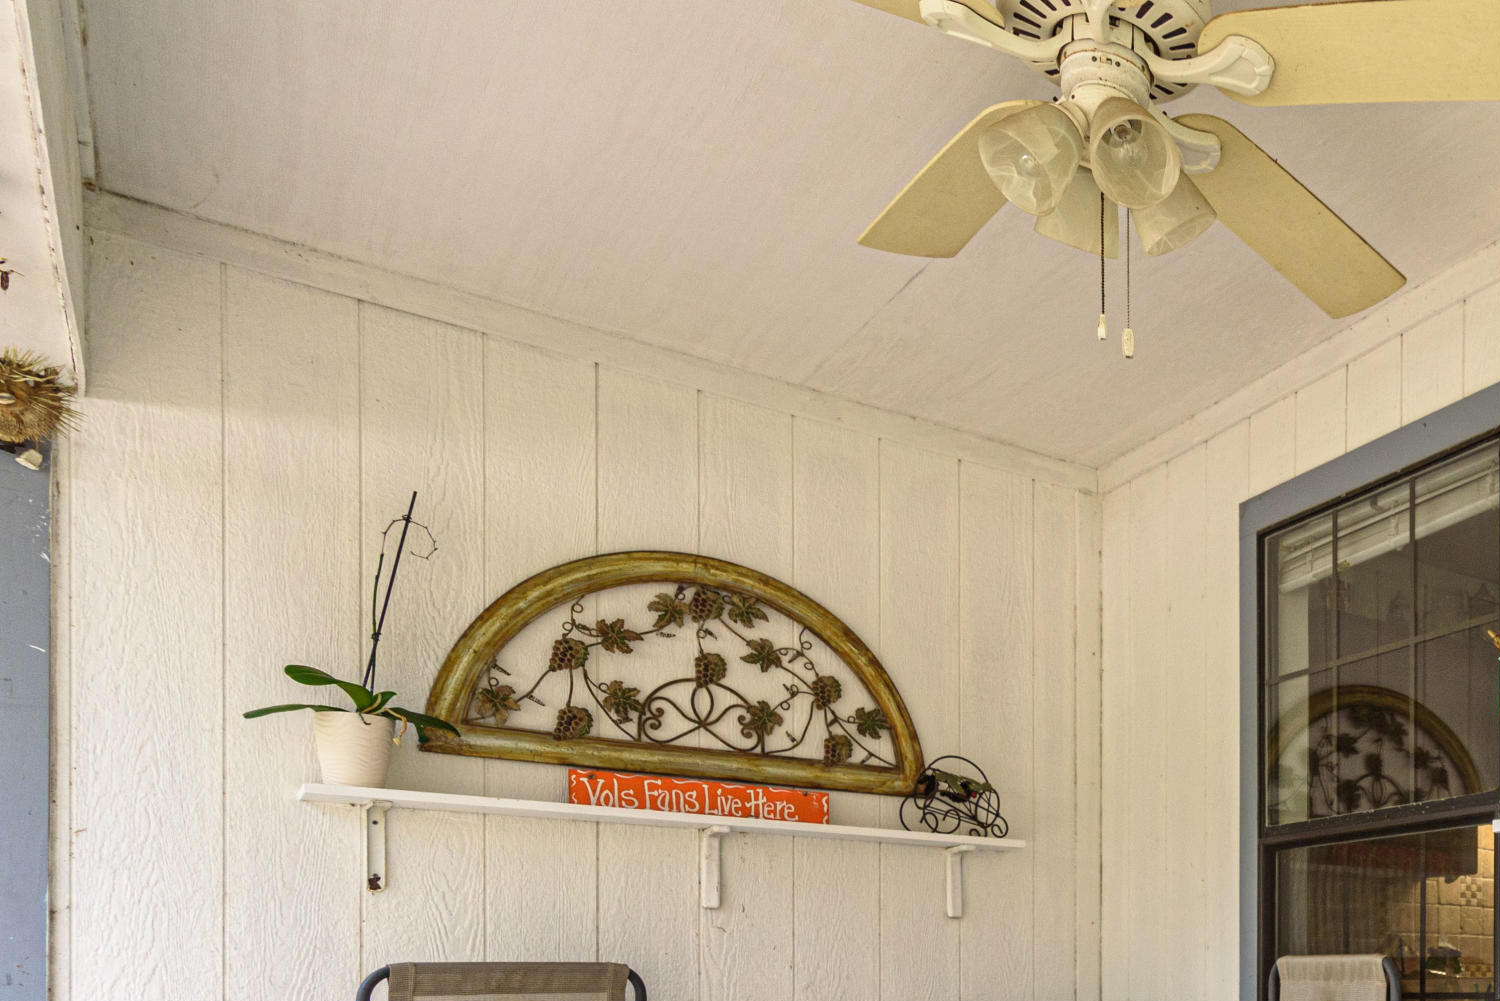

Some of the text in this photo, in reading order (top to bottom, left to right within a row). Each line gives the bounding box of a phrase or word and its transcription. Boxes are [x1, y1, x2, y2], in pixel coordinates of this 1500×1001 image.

[580, 777, 798, 821] Vols Fans Live Here
